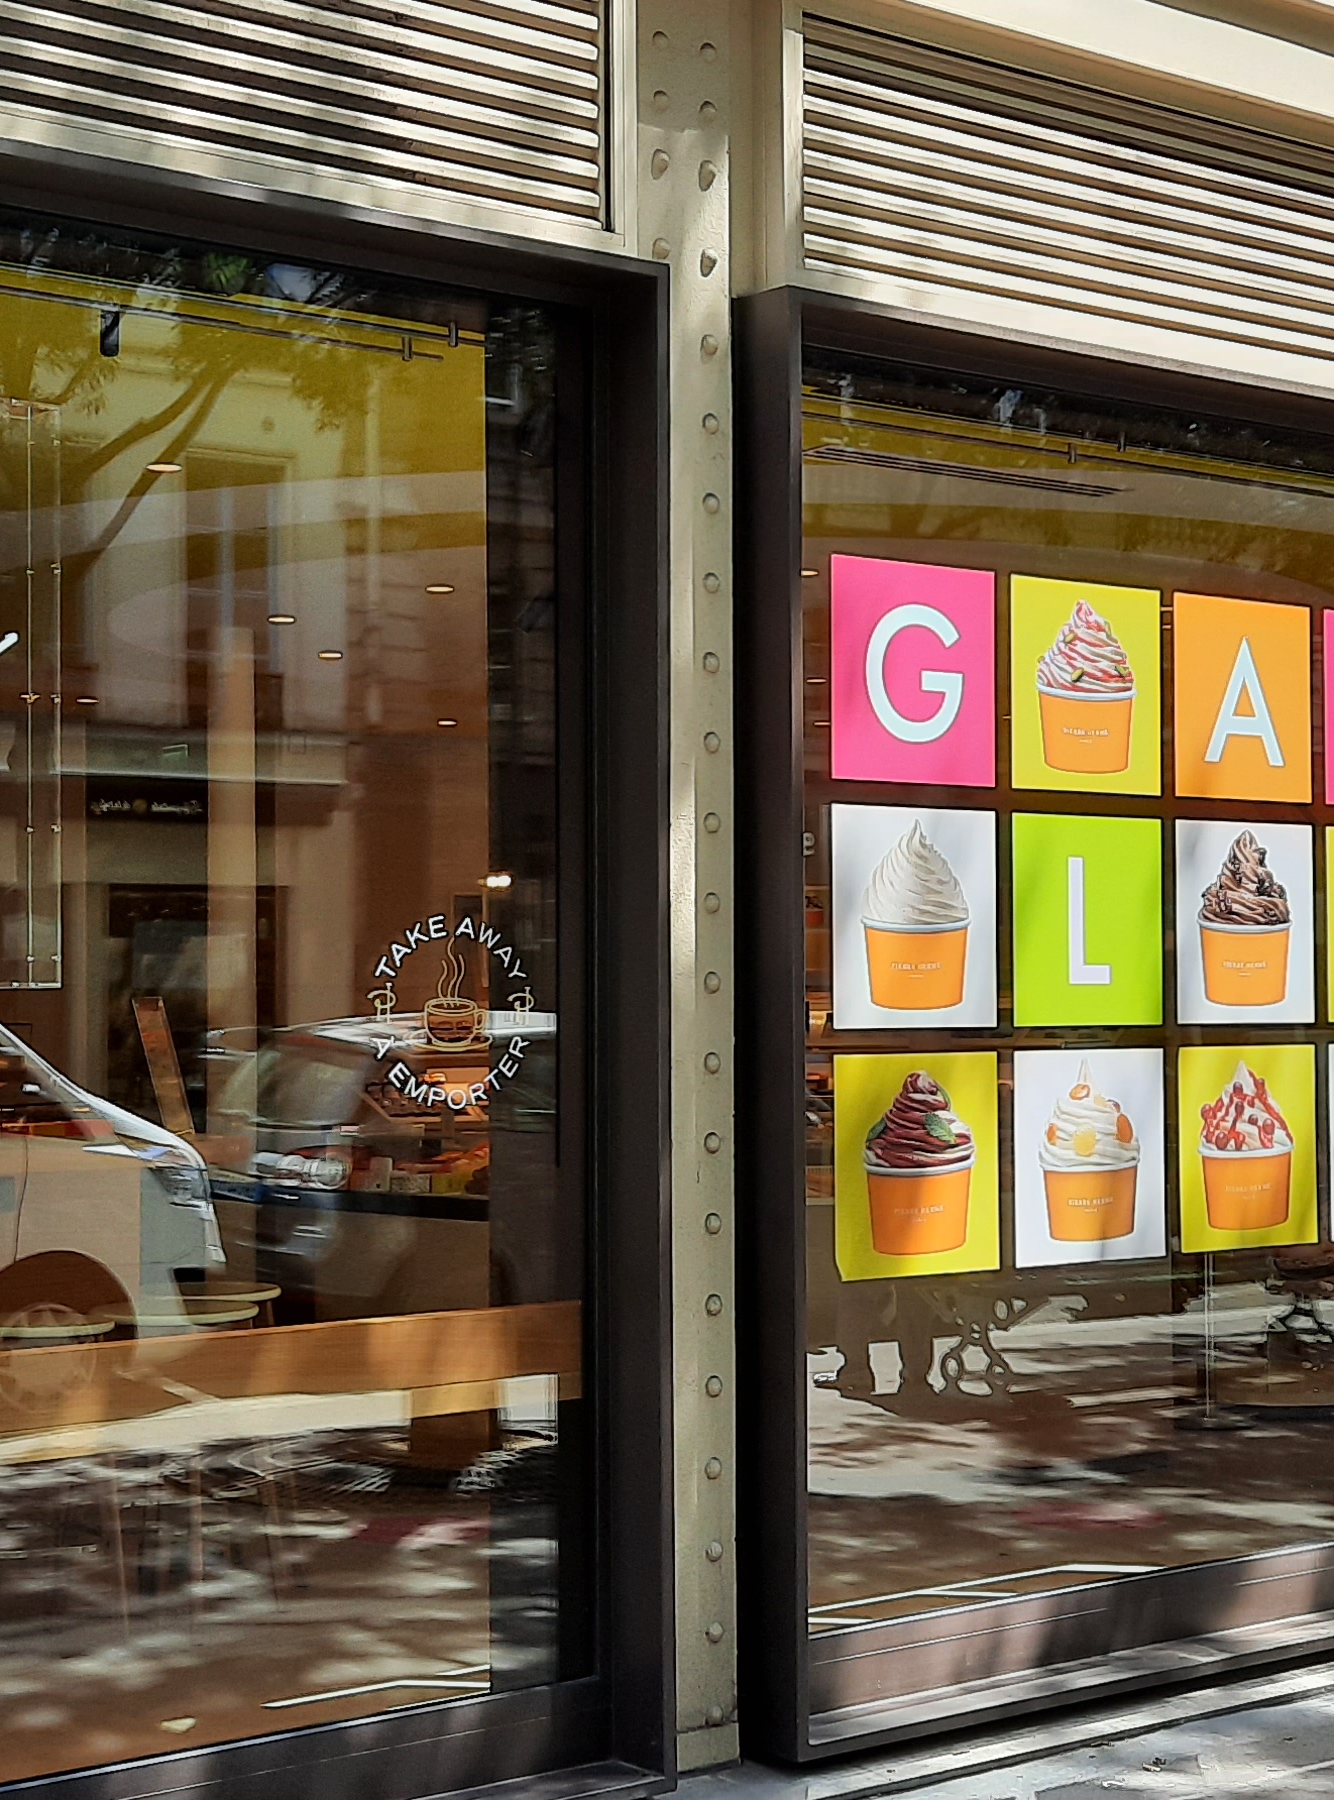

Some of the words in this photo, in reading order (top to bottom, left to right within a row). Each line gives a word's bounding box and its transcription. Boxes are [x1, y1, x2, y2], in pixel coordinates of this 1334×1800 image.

[865, 602, 965, 744] G
[1204, 636, 1284, 768] A
[374, 915, 448, 978] TAKE
[455, 916, 528, 978] AWAY
[1067, 856, 1111, 986] L
[388, 1035, 532, 1110] EMPORTER
